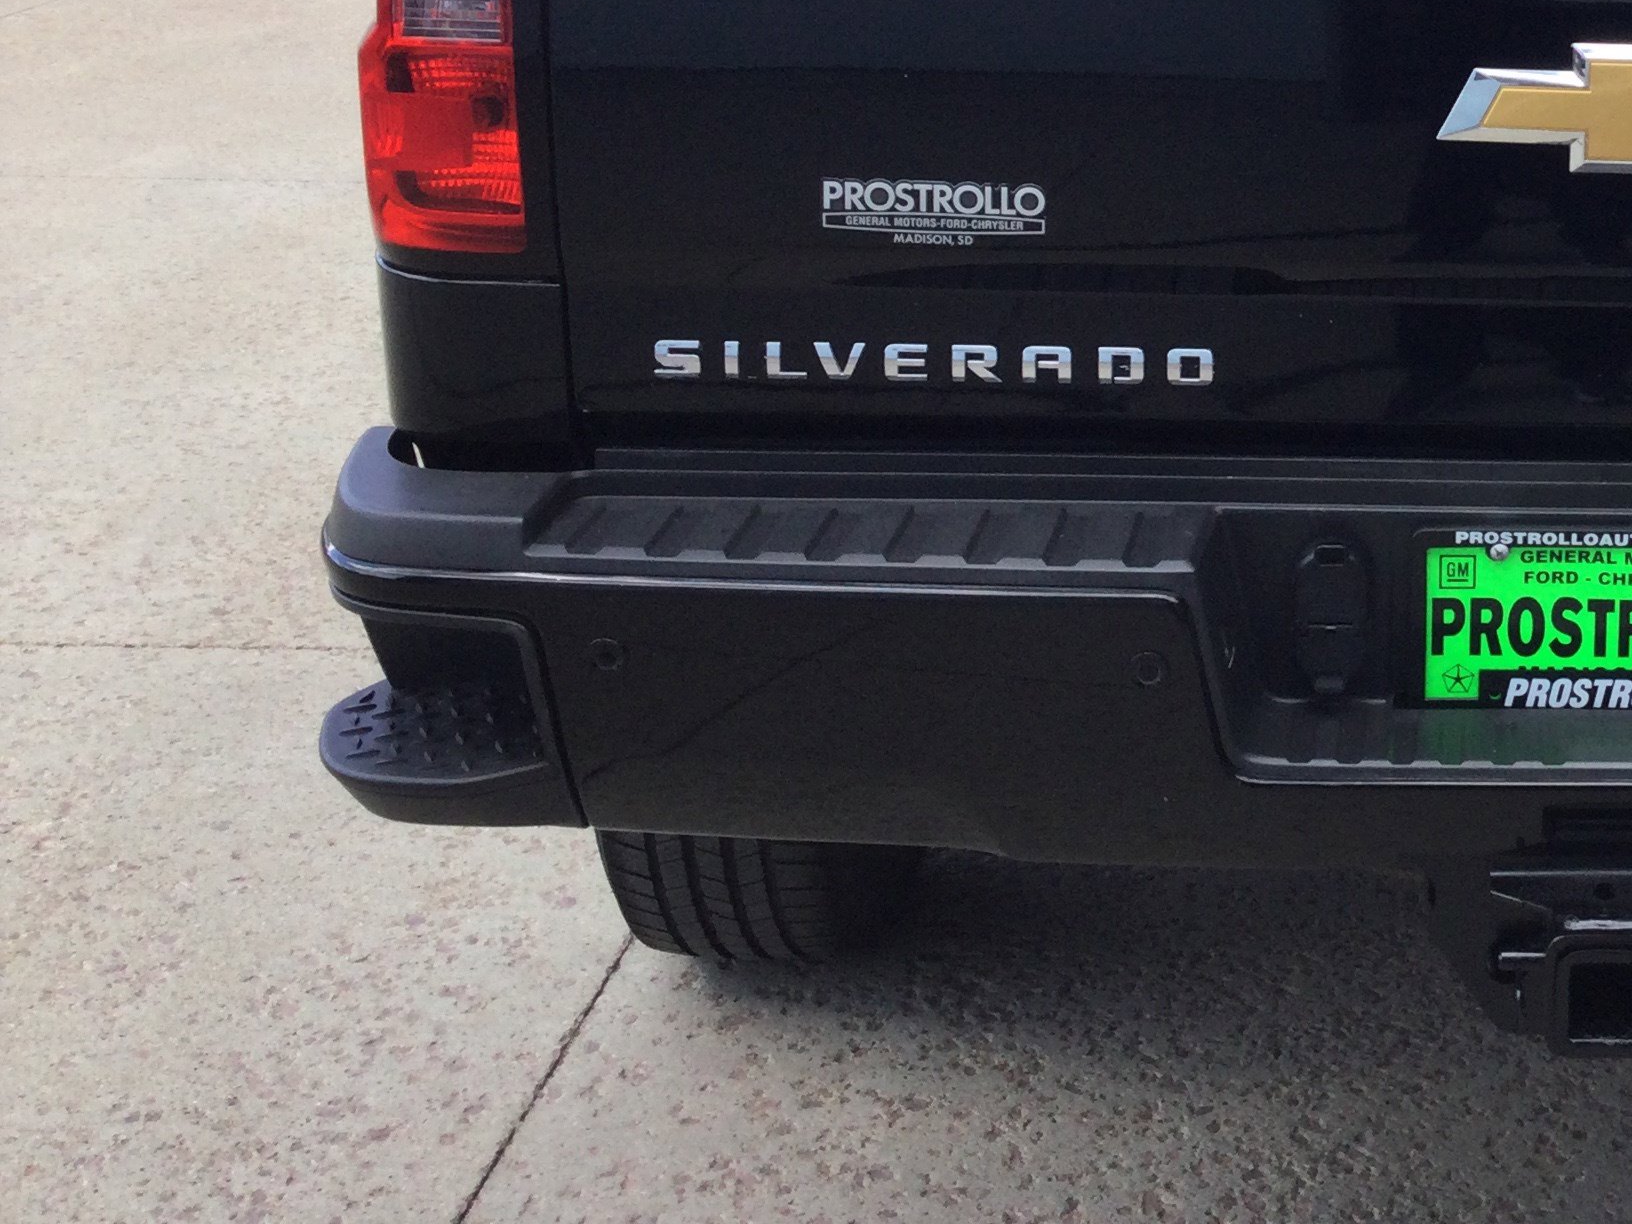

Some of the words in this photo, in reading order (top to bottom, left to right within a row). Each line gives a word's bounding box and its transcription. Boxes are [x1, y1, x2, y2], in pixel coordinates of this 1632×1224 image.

[822, 180, 1046, 216] PROSTROLLO
[845, 215, 891, 227] GENERAL
[893, 233, 954, 246] MADISON,
[957, 235, 974, 246] SD
[653, 339, 1214, 386] SILVERADO
[1519, 550, 1618, 565] GENERAL
[1446, 562, 1470, 579] GM
[1523, 571, 1579, 585] FORD
